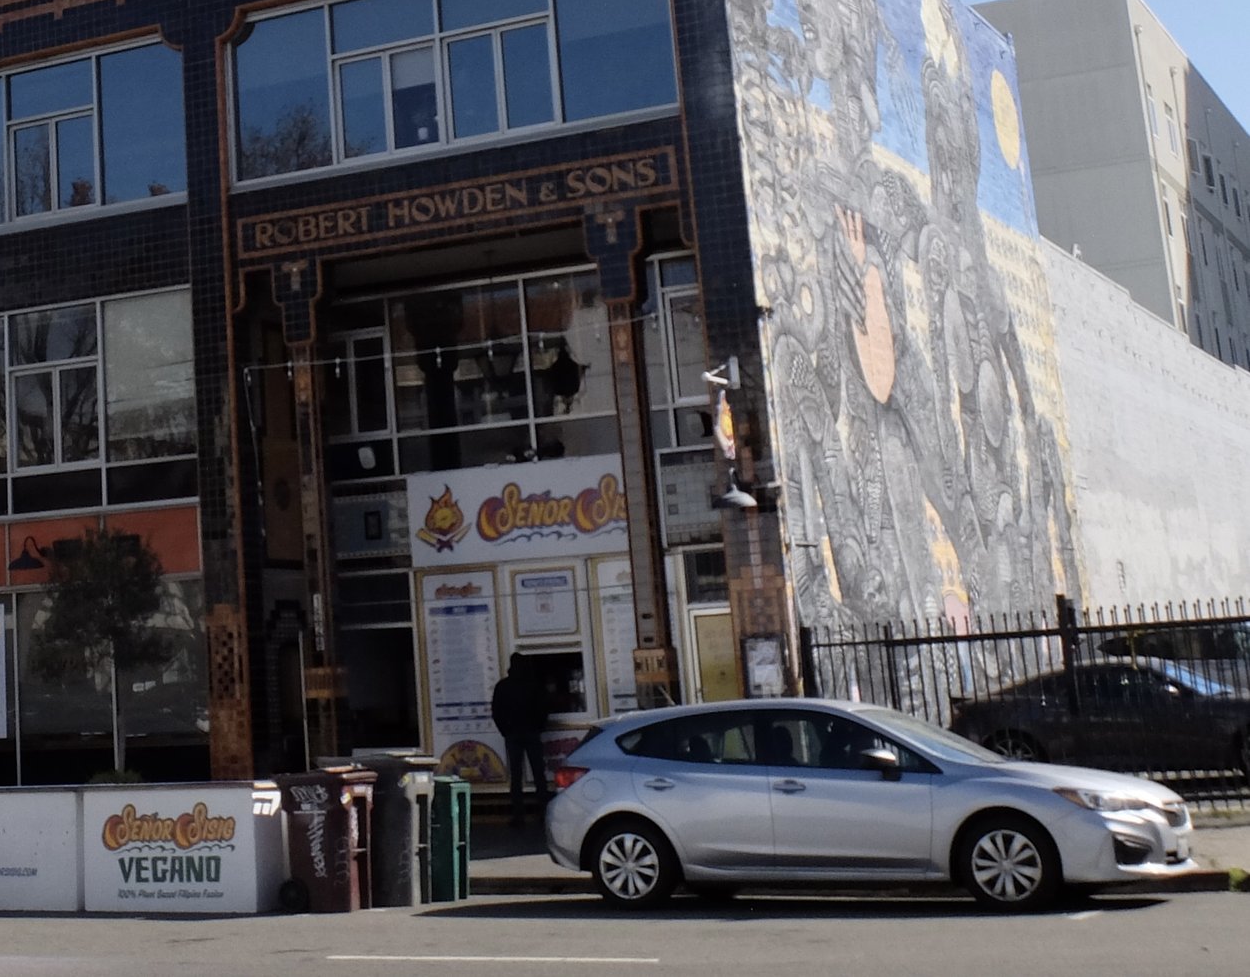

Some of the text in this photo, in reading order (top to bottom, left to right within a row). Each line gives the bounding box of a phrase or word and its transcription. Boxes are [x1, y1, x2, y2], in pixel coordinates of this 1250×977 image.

[254, 157, 657, 249] ROBERT HOWDEN & SONS
[175, 802, 235, 850] SISIG
[118, 855, 221, 883] VEGANO
